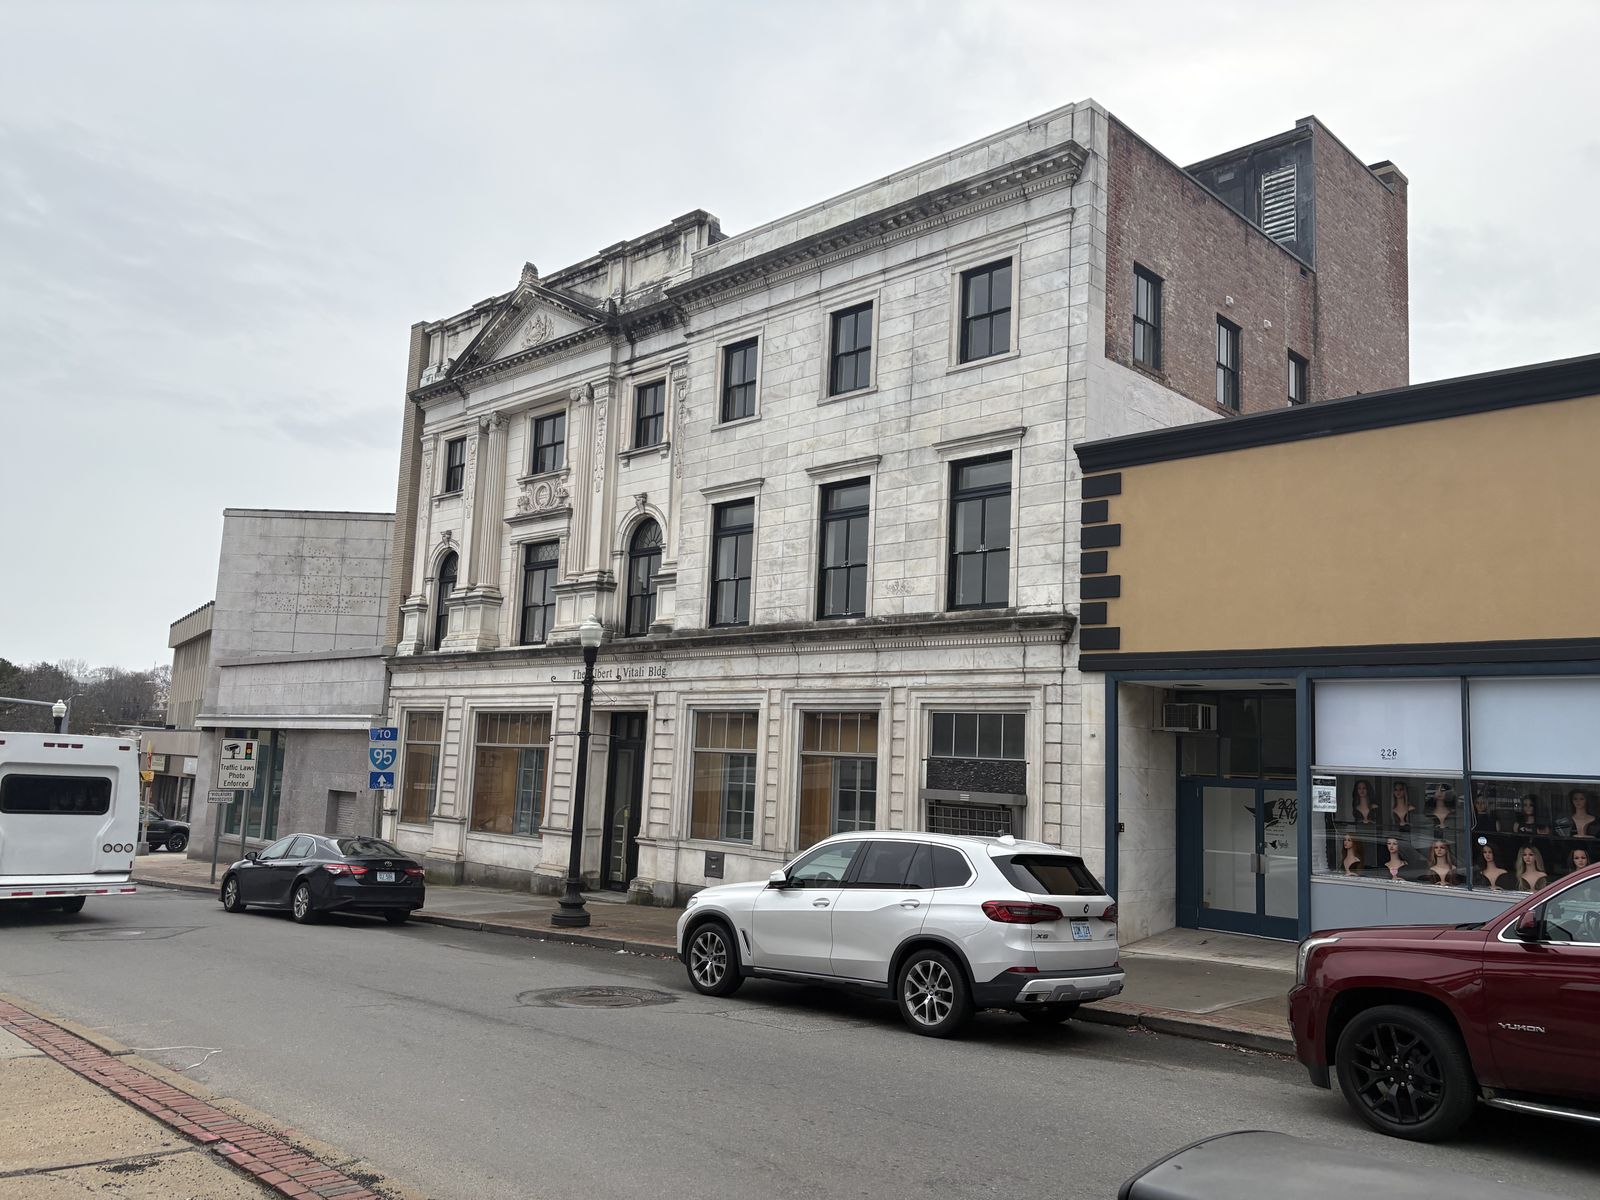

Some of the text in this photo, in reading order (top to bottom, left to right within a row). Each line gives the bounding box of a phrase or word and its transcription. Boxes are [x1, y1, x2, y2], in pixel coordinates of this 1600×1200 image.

[572, 669, 586, 679] The
[623, 666, 645, 677] Vitali
[377, 729, 391, 739] TO
[373, 749, 392, 765] 95
[1380, 748, 1398, 757] 226
[1497, 1022, 1546, 1033] YUKON
